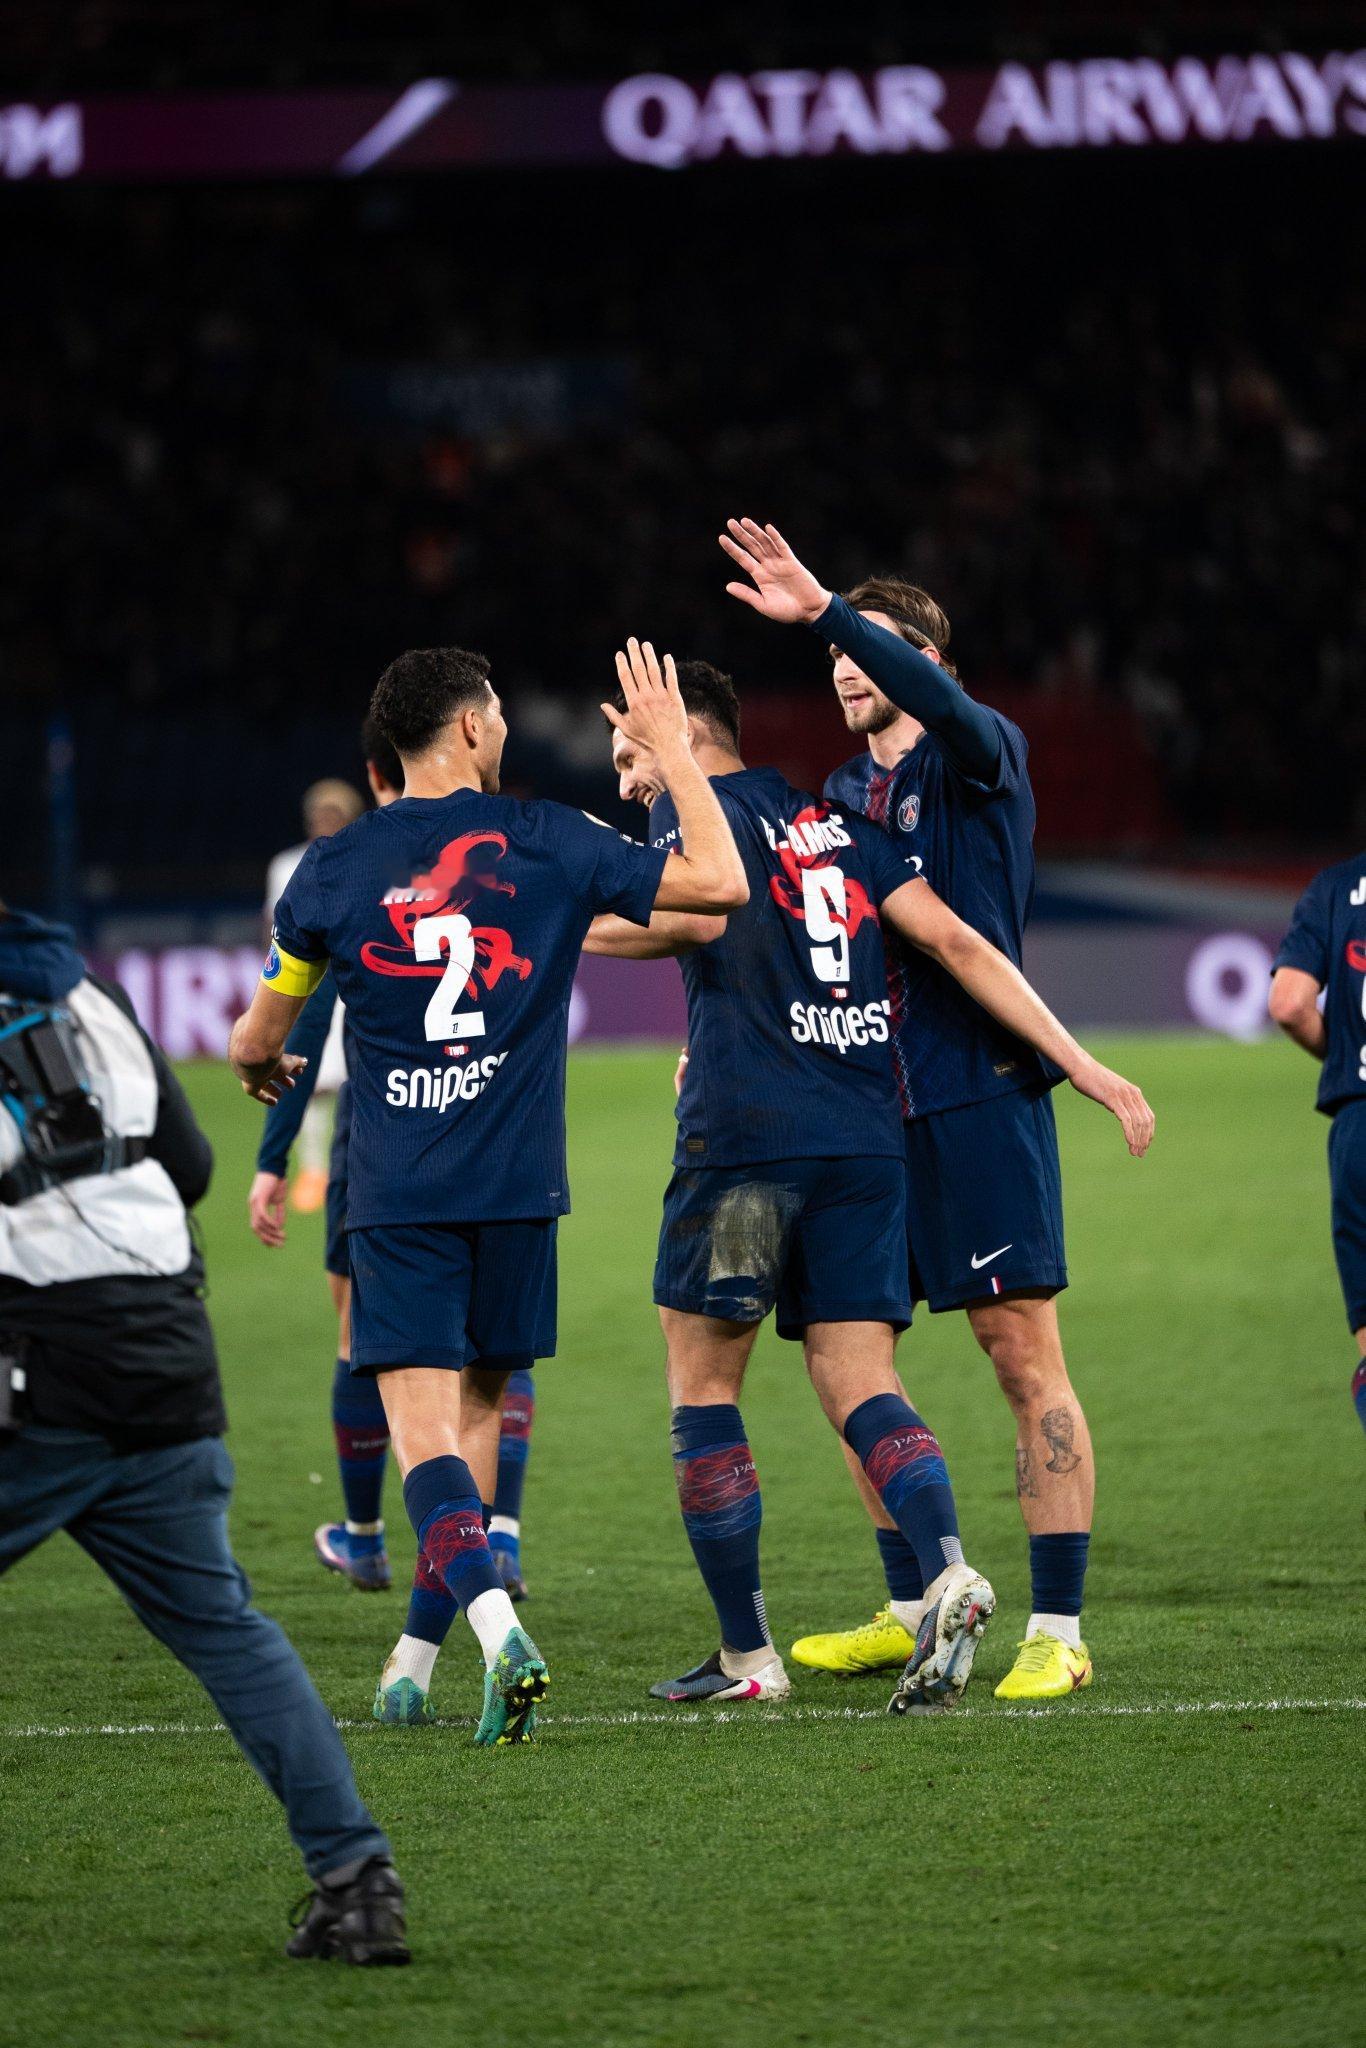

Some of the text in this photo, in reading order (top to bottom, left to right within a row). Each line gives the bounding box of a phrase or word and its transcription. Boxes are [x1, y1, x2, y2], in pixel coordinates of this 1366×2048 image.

[602, 52, 1366, 168] QATAR AIRWAYS
[413, 913, 486, 1042] 2
[802, 865, 850, 982] 9
